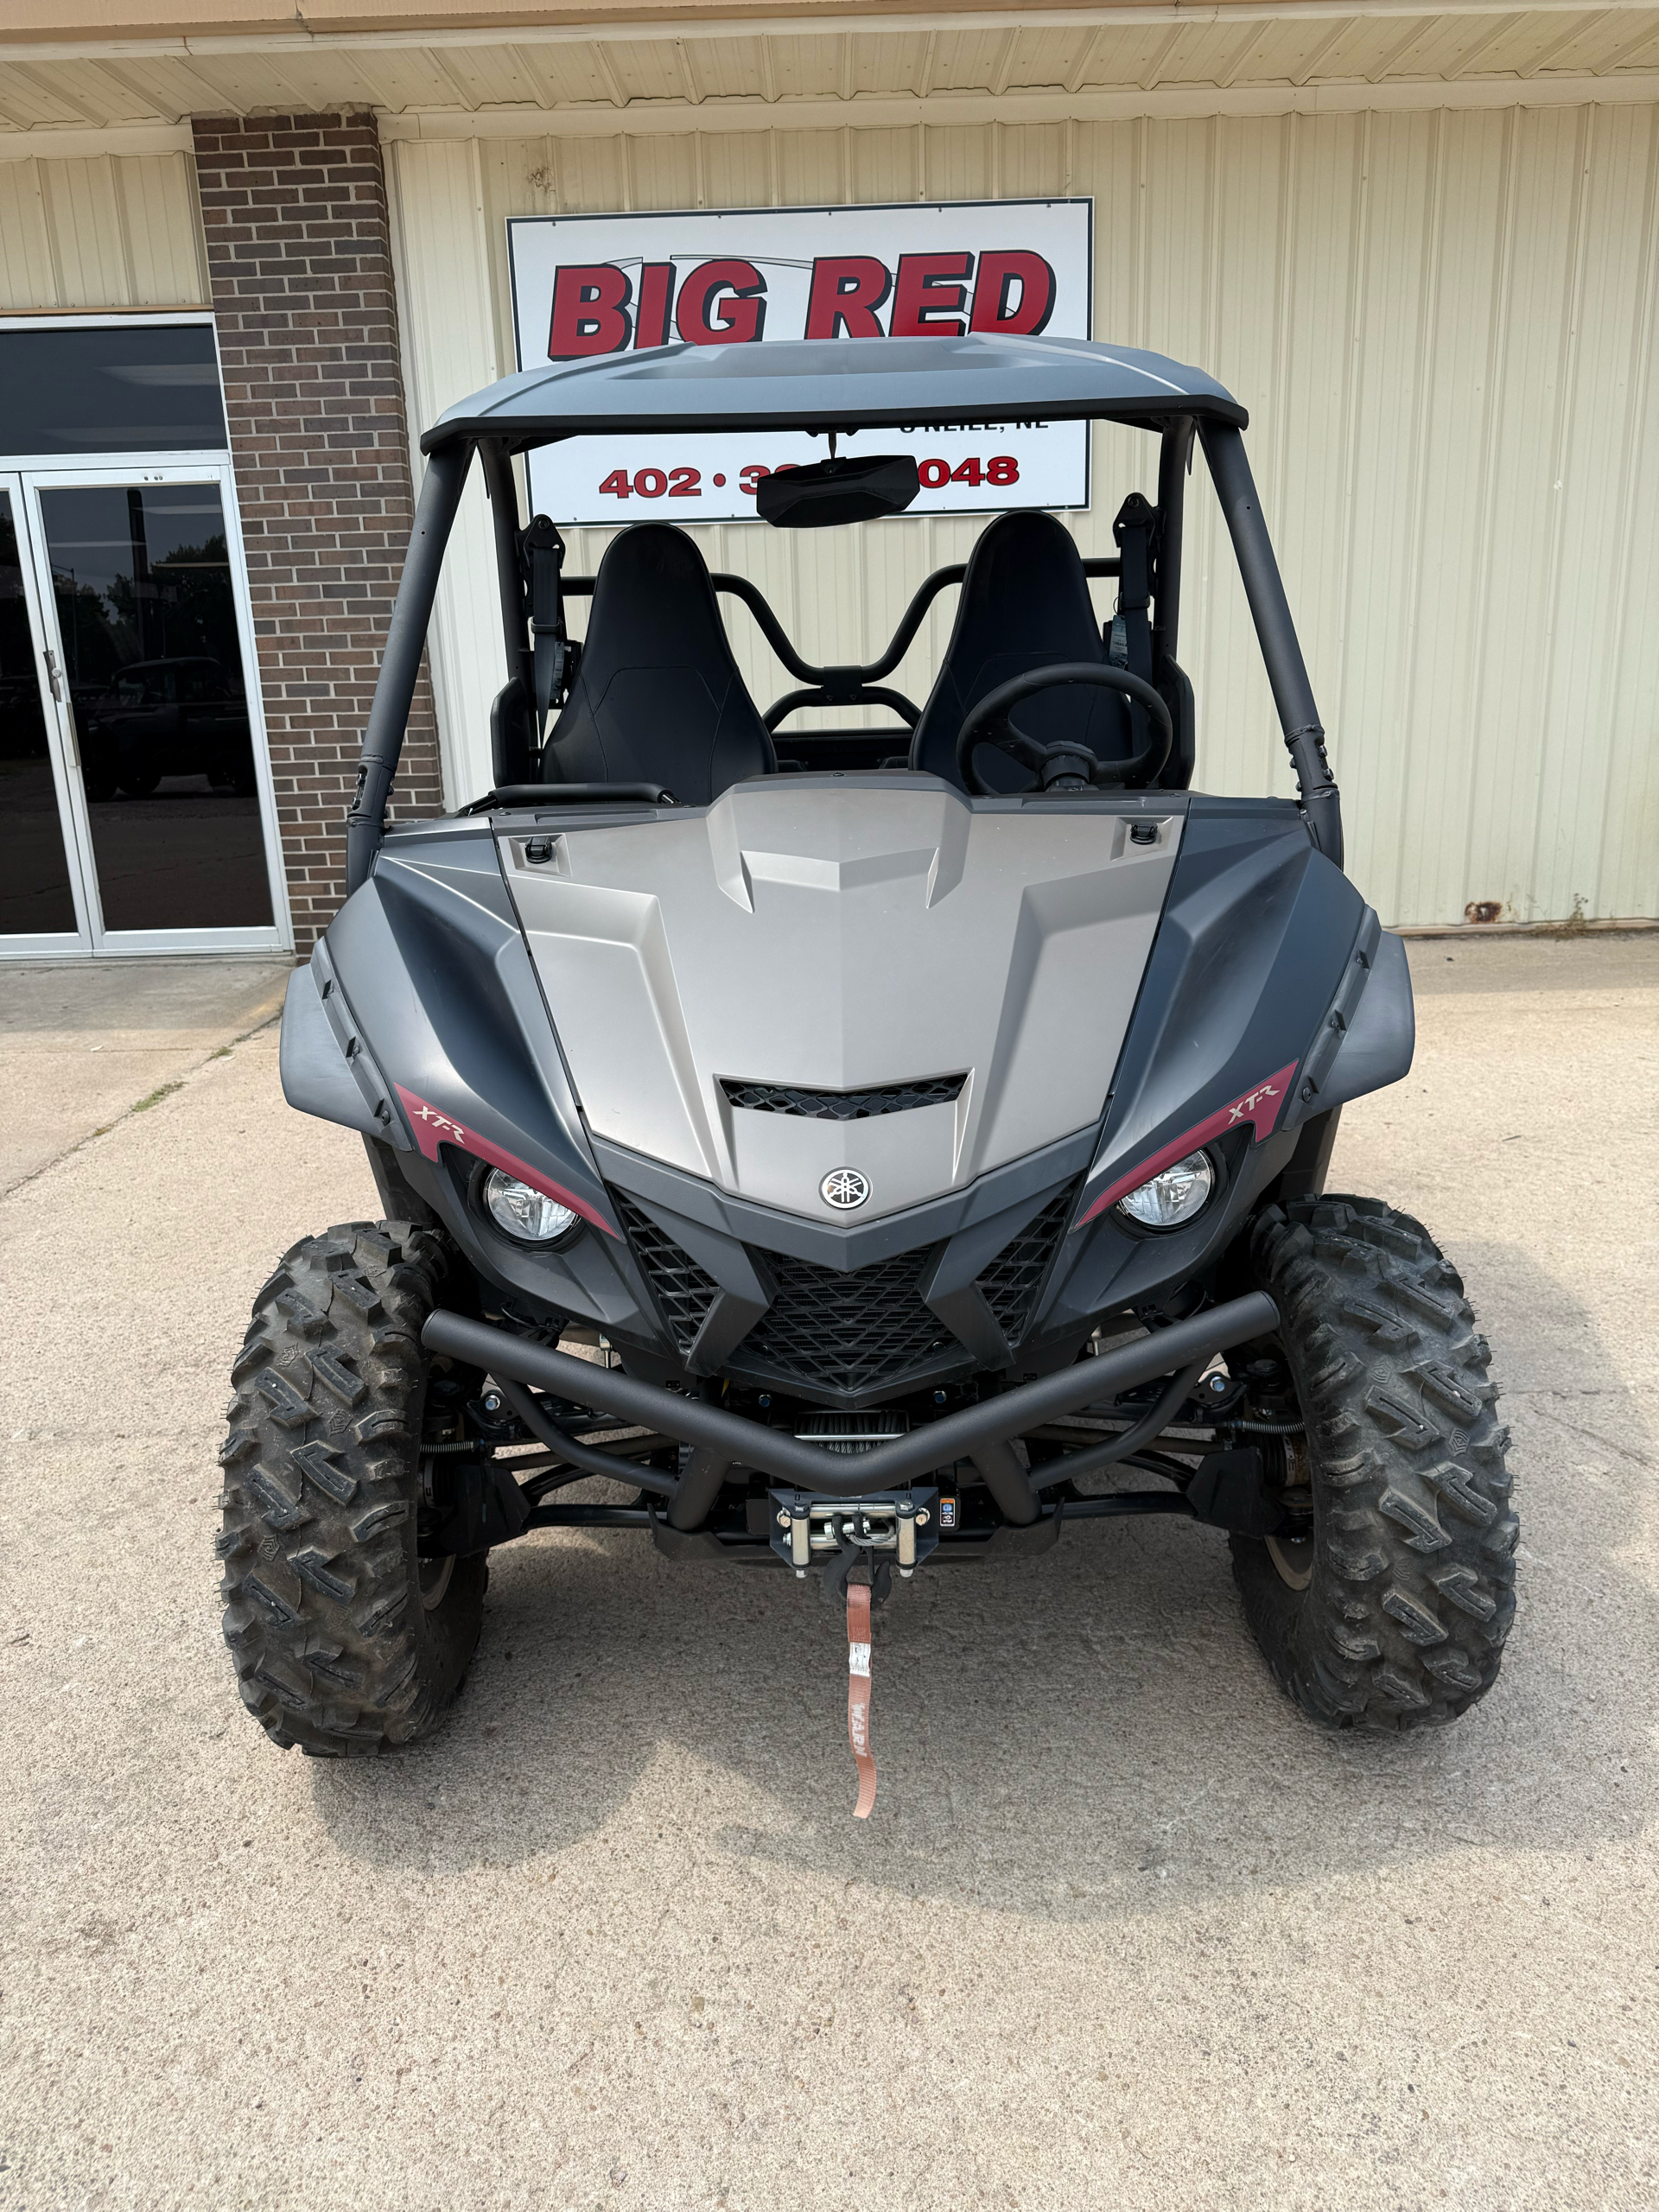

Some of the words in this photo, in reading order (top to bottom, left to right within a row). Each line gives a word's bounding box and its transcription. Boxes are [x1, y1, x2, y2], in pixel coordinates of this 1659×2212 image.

[547, 257, 767, 361] BIG
[804, 249, 1057, 340] RED
[599, 467, 702, 499] 402
[412, 1105, 465, 1144] XT-R
[1228, 1084, 1281, 1125] XT-R
[850, 1703, 868, 1758] WARN
